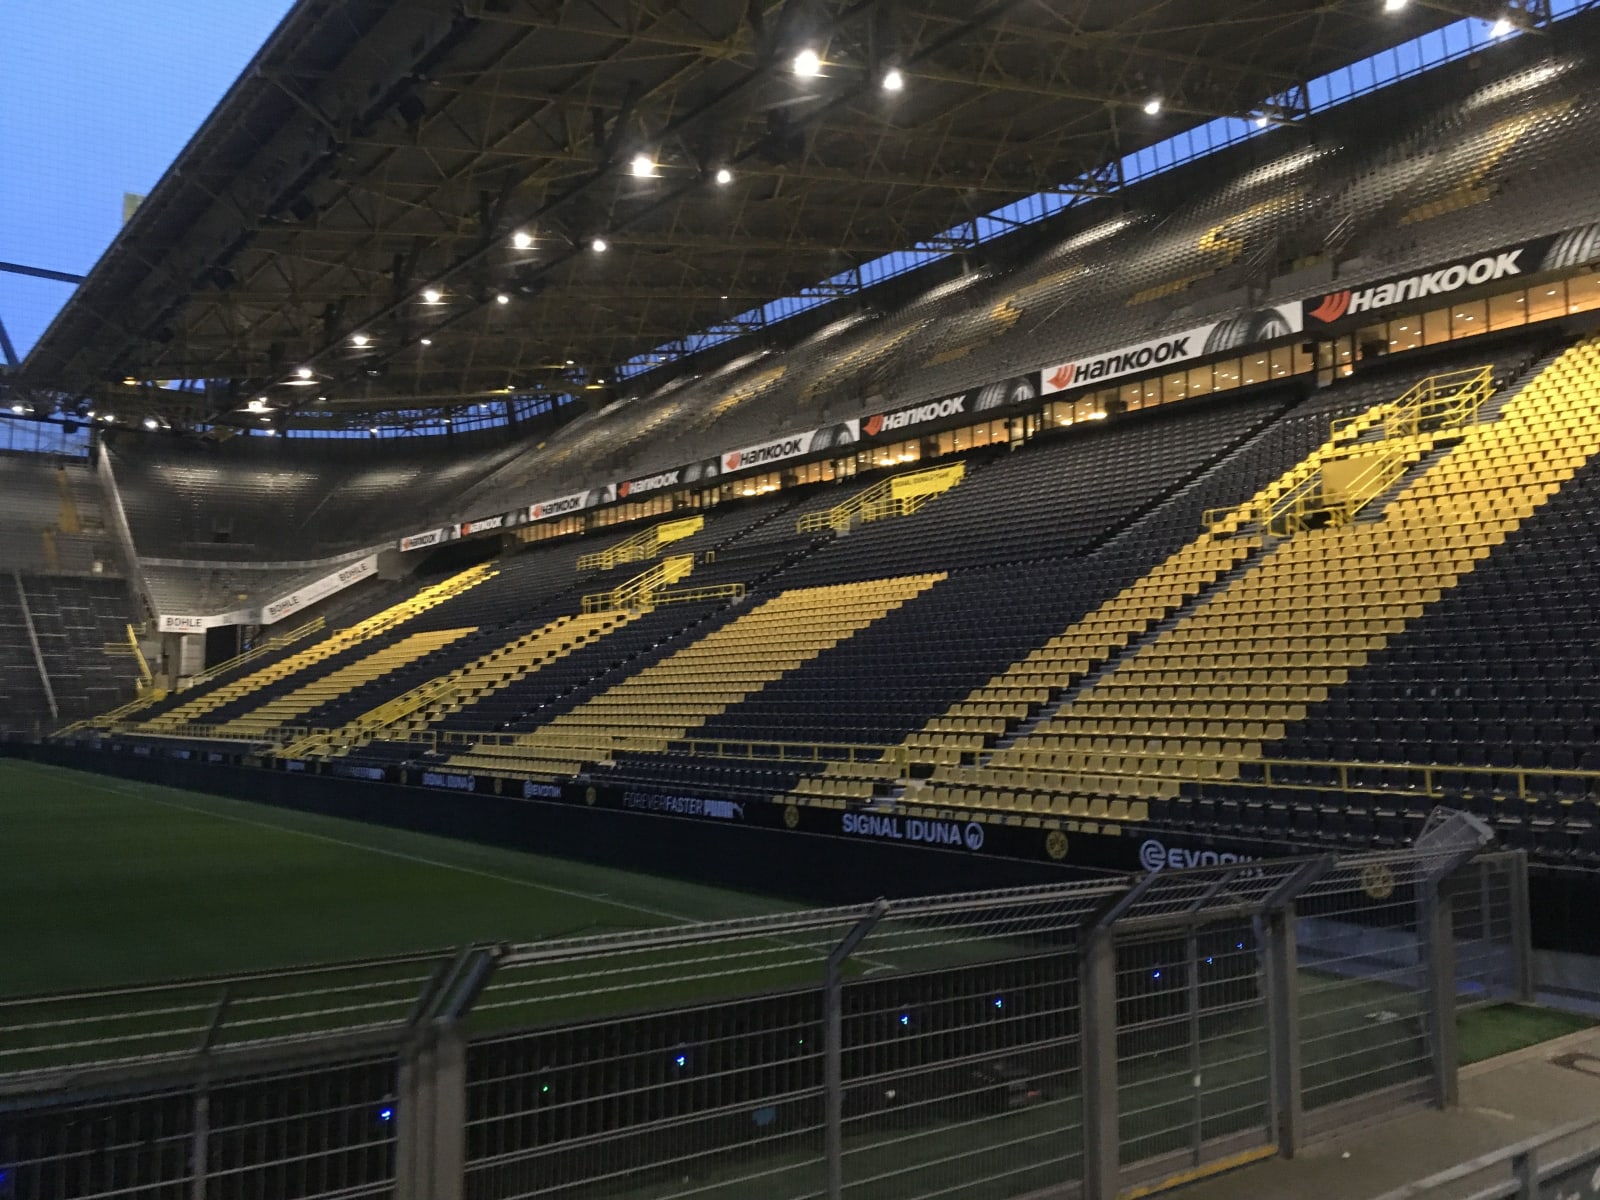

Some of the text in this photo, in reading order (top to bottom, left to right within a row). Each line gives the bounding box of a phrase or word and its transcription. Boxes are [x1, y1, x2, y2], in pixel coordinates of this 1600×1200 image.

[166, 618, 201, 628] BOHLE
[843, 814, 961, 844] SIGNAL IDUNA
